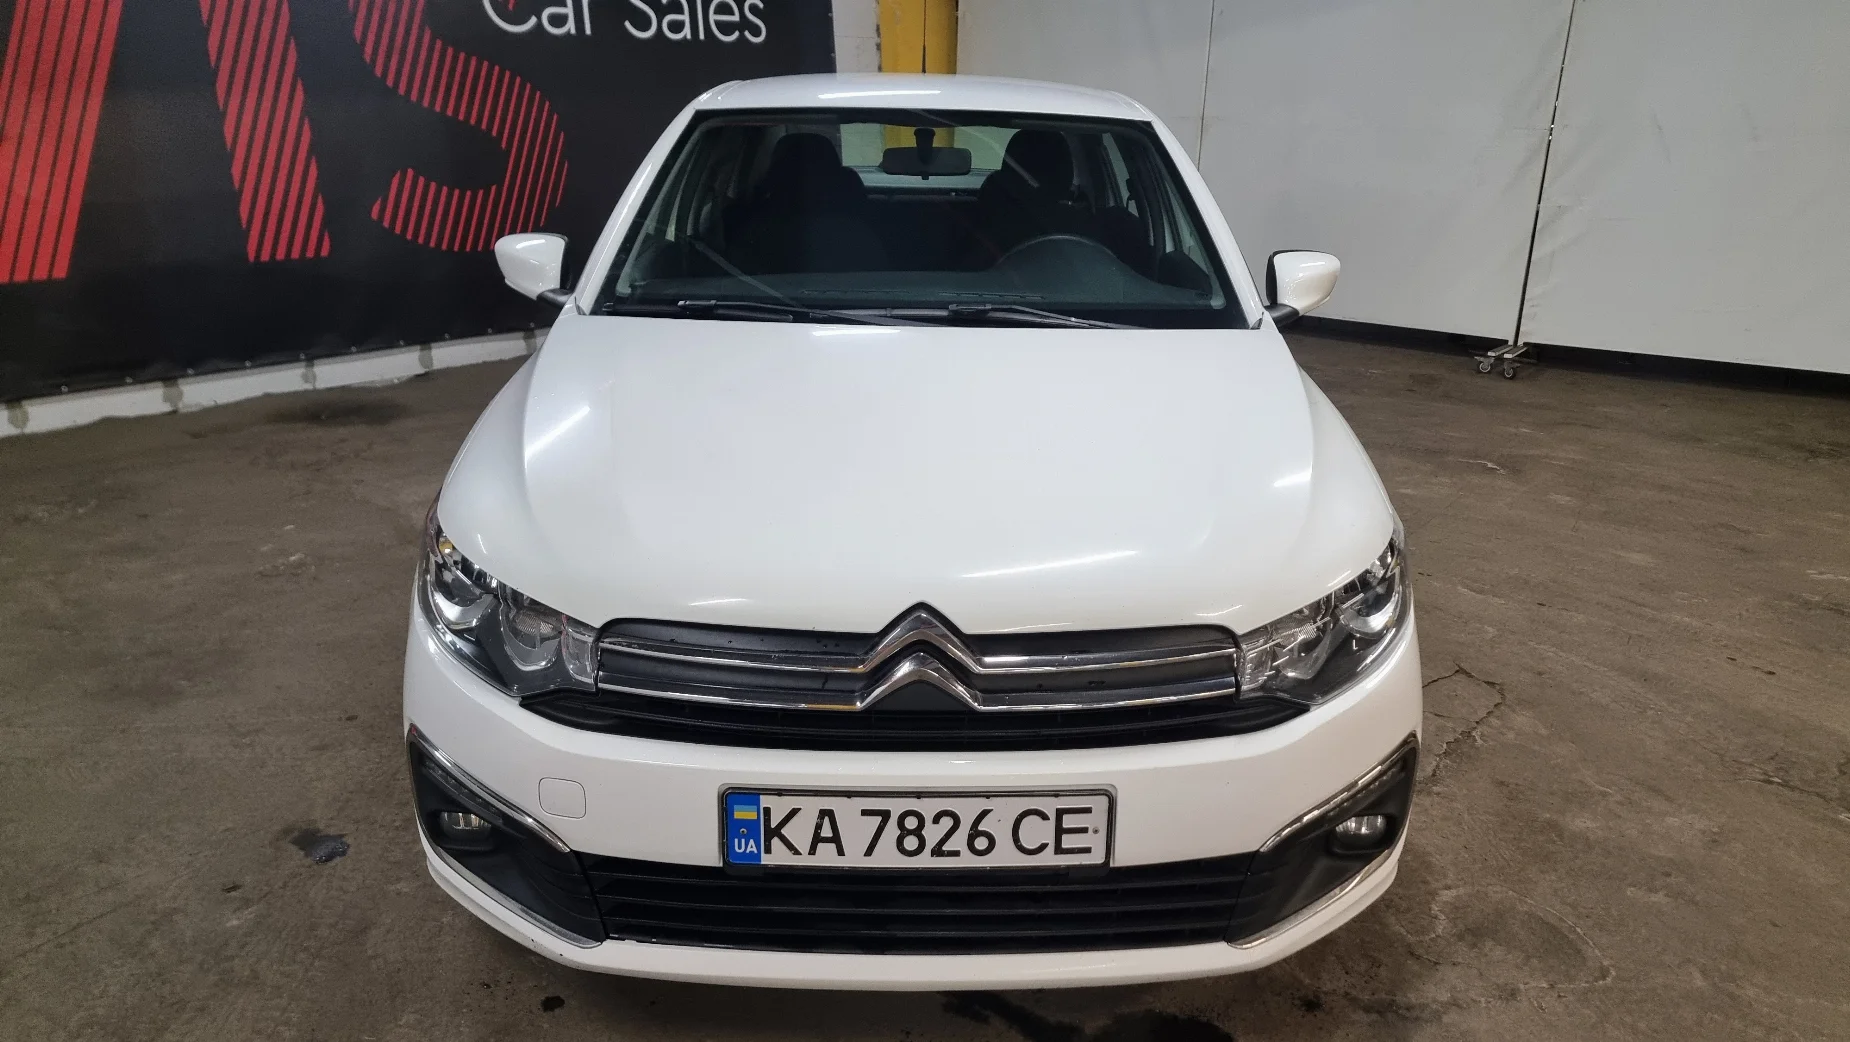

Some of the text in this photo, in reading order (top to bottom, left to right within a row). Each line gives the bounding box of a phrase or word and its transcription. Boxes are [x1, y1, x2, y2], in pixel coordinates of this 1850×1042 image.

[482, 0, 767, 44] Car Sales
[734, 838, 758, 854] UA
[763, 806, 1093, 858] KA 7826 CE
